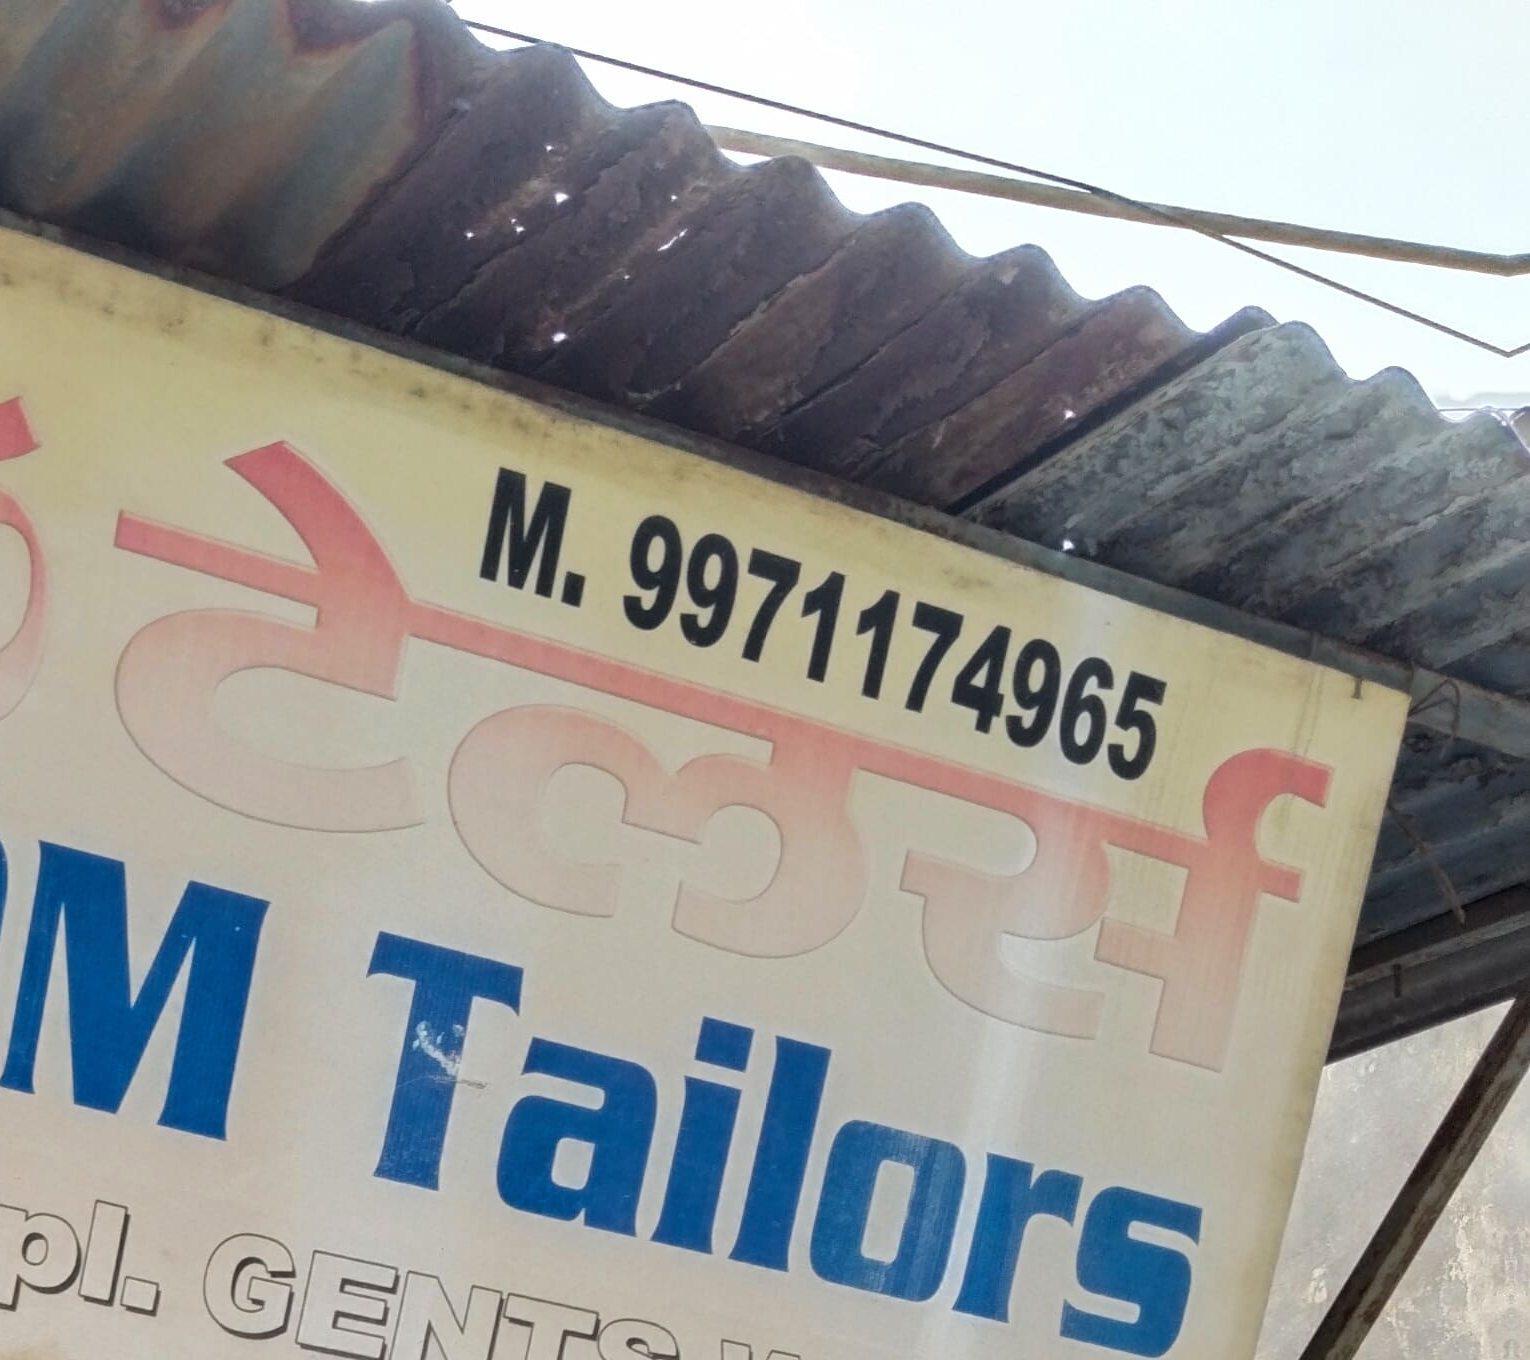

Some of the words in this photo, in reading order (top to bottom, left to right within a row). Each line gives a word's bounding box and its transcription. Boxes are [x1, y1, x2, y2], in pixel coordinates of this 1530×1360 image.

[114, 440, 1334, 1073] टेलर्स
[480, 467, 587, 607] M.
[622, 515, 1168, 781] 9971174965
[366, 931, 1204, 1359] Tailors
